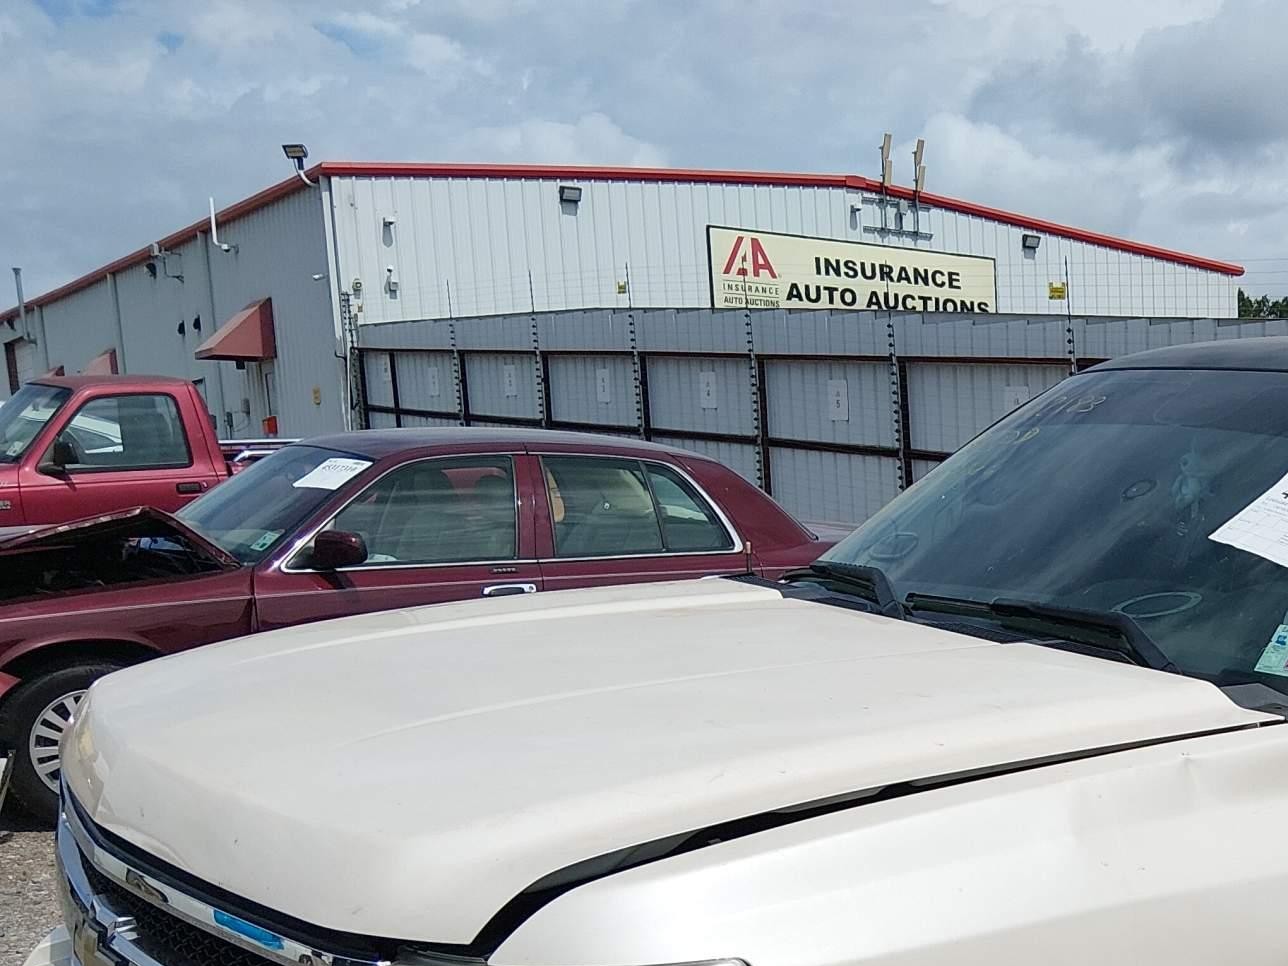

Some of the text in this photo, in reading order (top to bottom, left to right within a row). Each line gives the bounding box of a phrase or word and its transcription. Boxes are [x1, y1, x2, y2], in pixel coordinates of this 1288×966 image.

[814, 256, 961, 290] INSURANCE
[723, 283, 779, 296] INSURANCE
[786, 283, 990, 312] AUTO AUCTIONS
[724, 296, 780, 308] AUTO AUCTIONS
